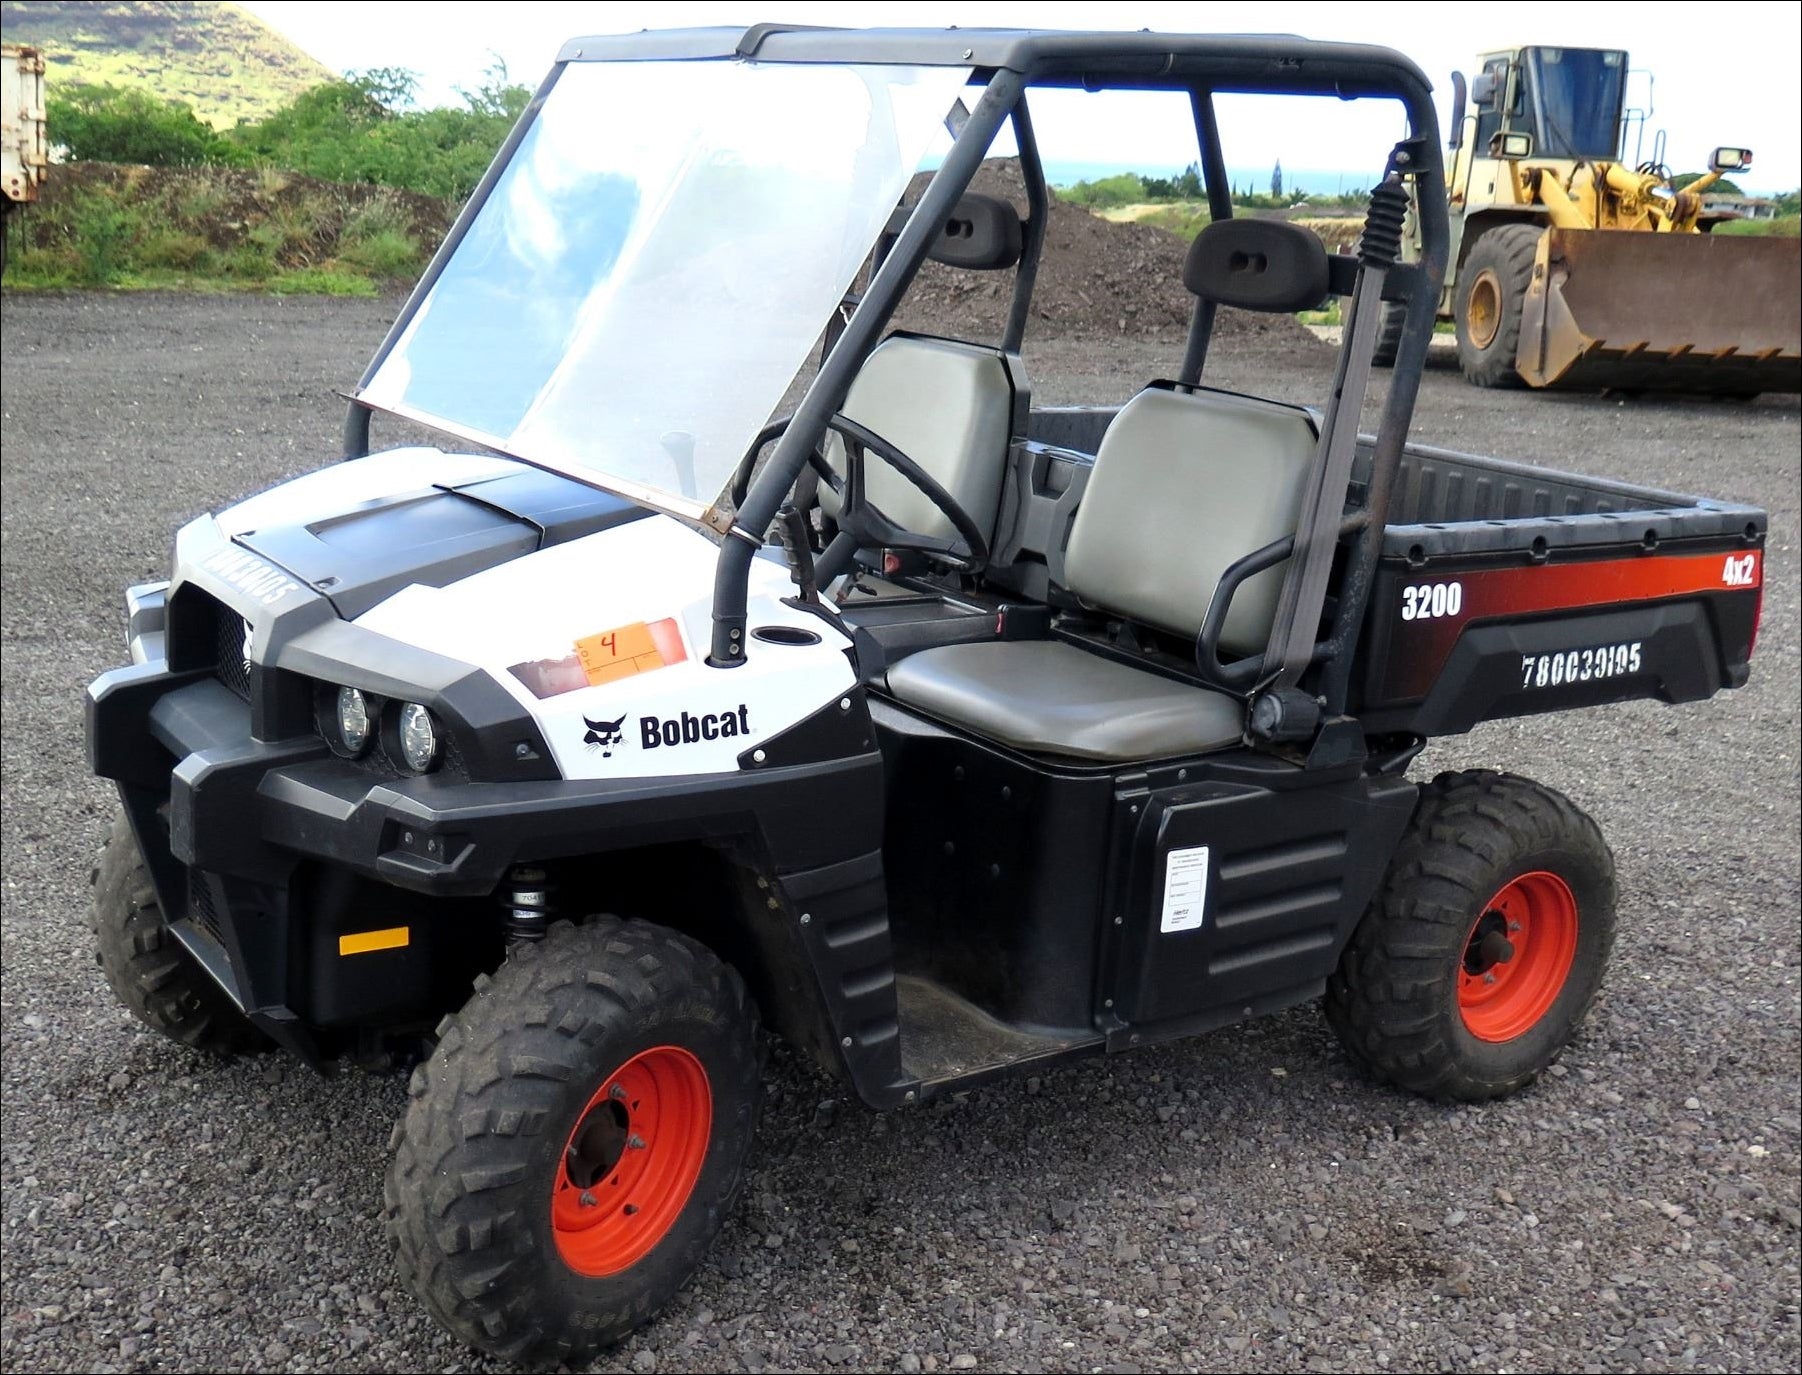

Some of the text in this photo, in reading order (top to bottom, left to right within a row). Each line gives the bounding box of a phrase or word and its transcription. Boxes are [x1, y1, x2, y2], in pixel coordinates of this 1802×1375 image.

[1721, 554, 1755, 587] 4x2
[1401, 581, 1462, 622] 3200
[577, 642, 591, 666] LOT
[601, 632, 616, 657] 4
[640, 704, 750, 750] Bobcat
